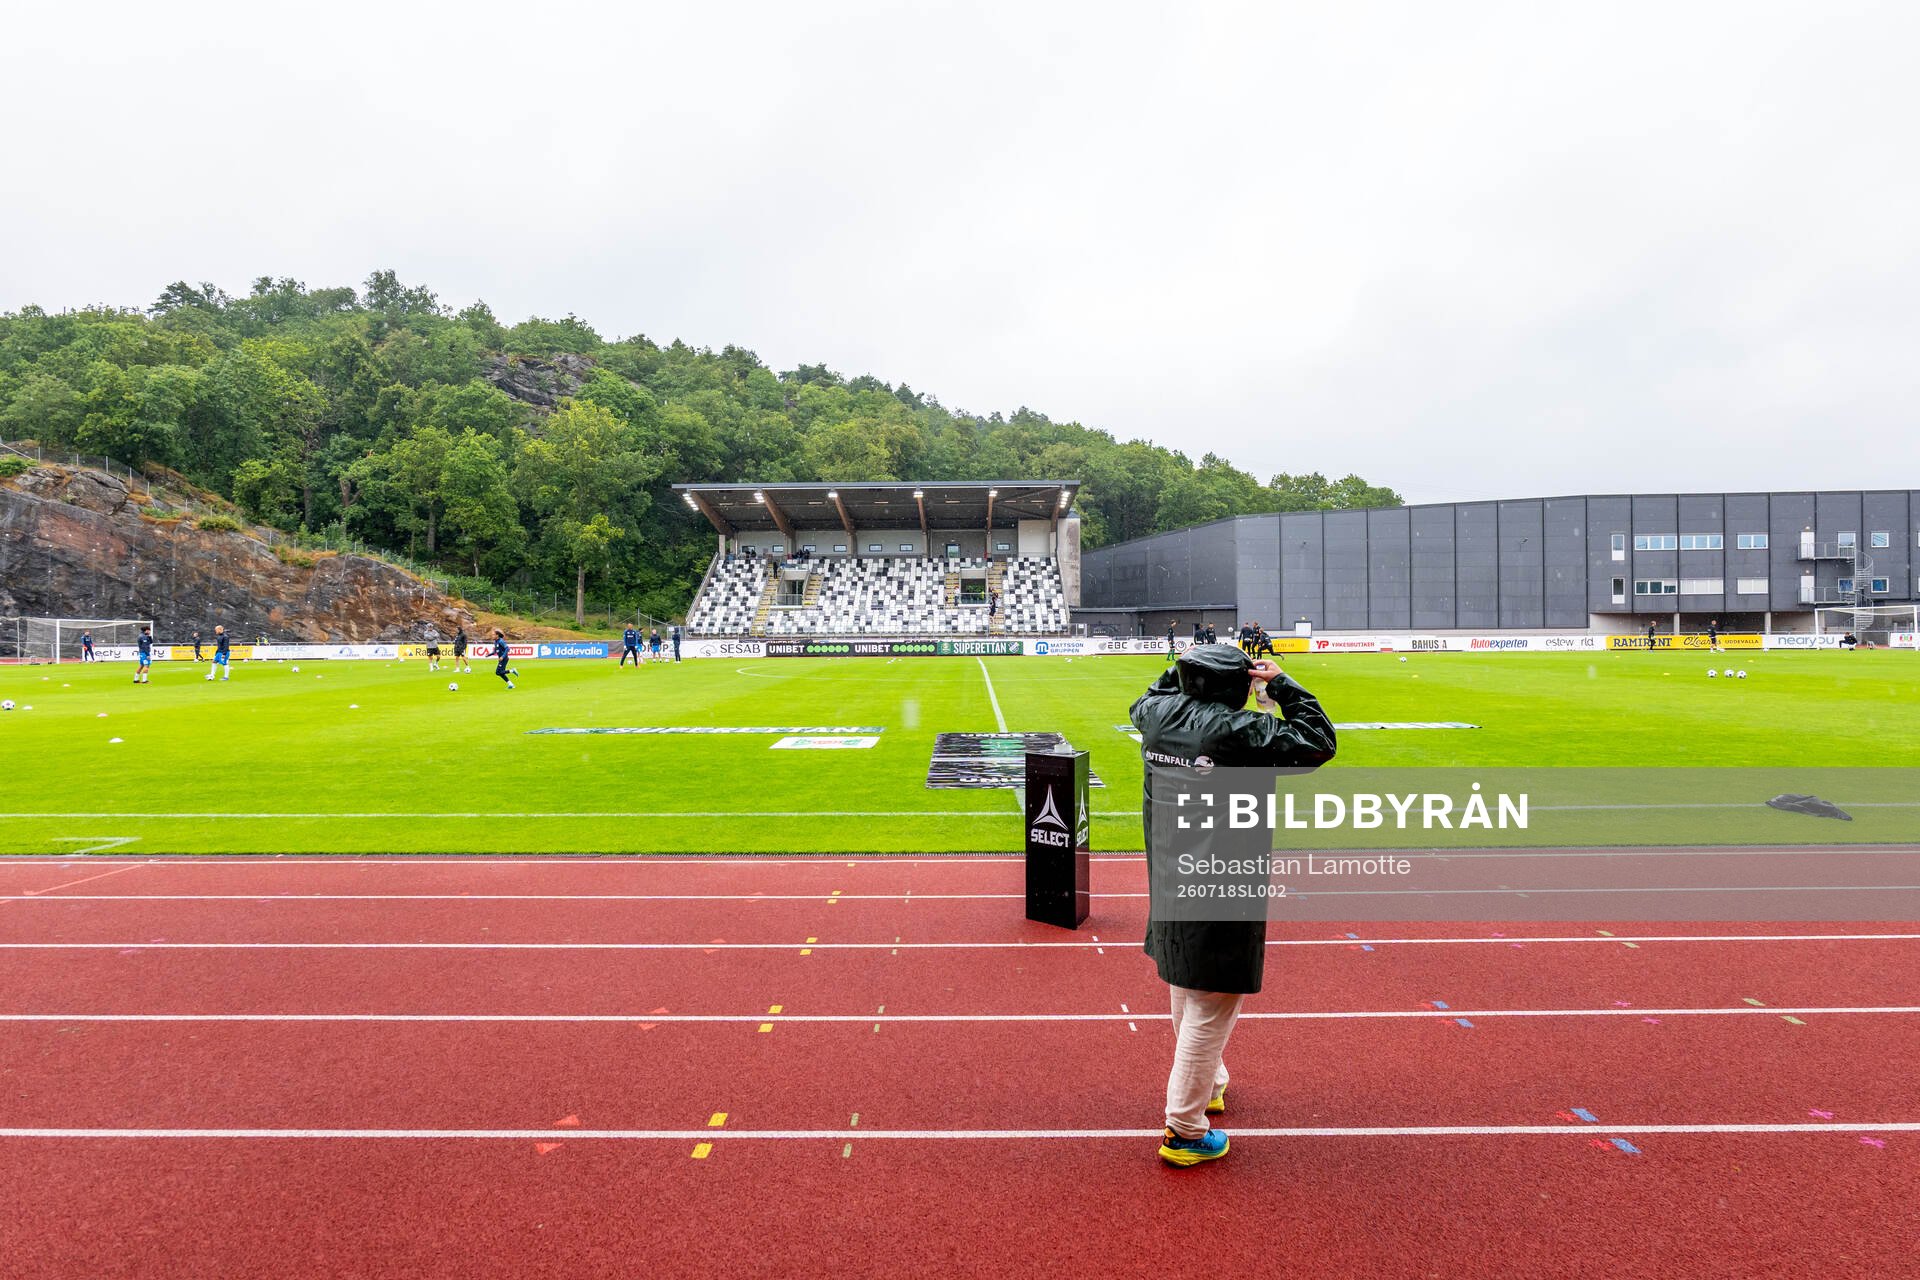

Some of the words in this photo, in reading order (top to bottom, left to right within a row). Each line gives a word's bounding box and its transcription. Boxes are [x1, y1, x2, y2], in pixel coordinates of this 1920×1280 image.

[720, 644, 761, 653] SESAB
[854, 644, 890, 653] UNIBET
[953, 642, 1007, 654] SUPERETTAN
[1471, 638, 1528, 649] Autoexperten
[94, 648, 121, 658] ecty
[131, 649, 165, 658] nty
[554, 644, 603, 656] Uddevalla
[768, 645, 805, 653] UNIBET
[1030, 828, 1070, 848] SELECT
